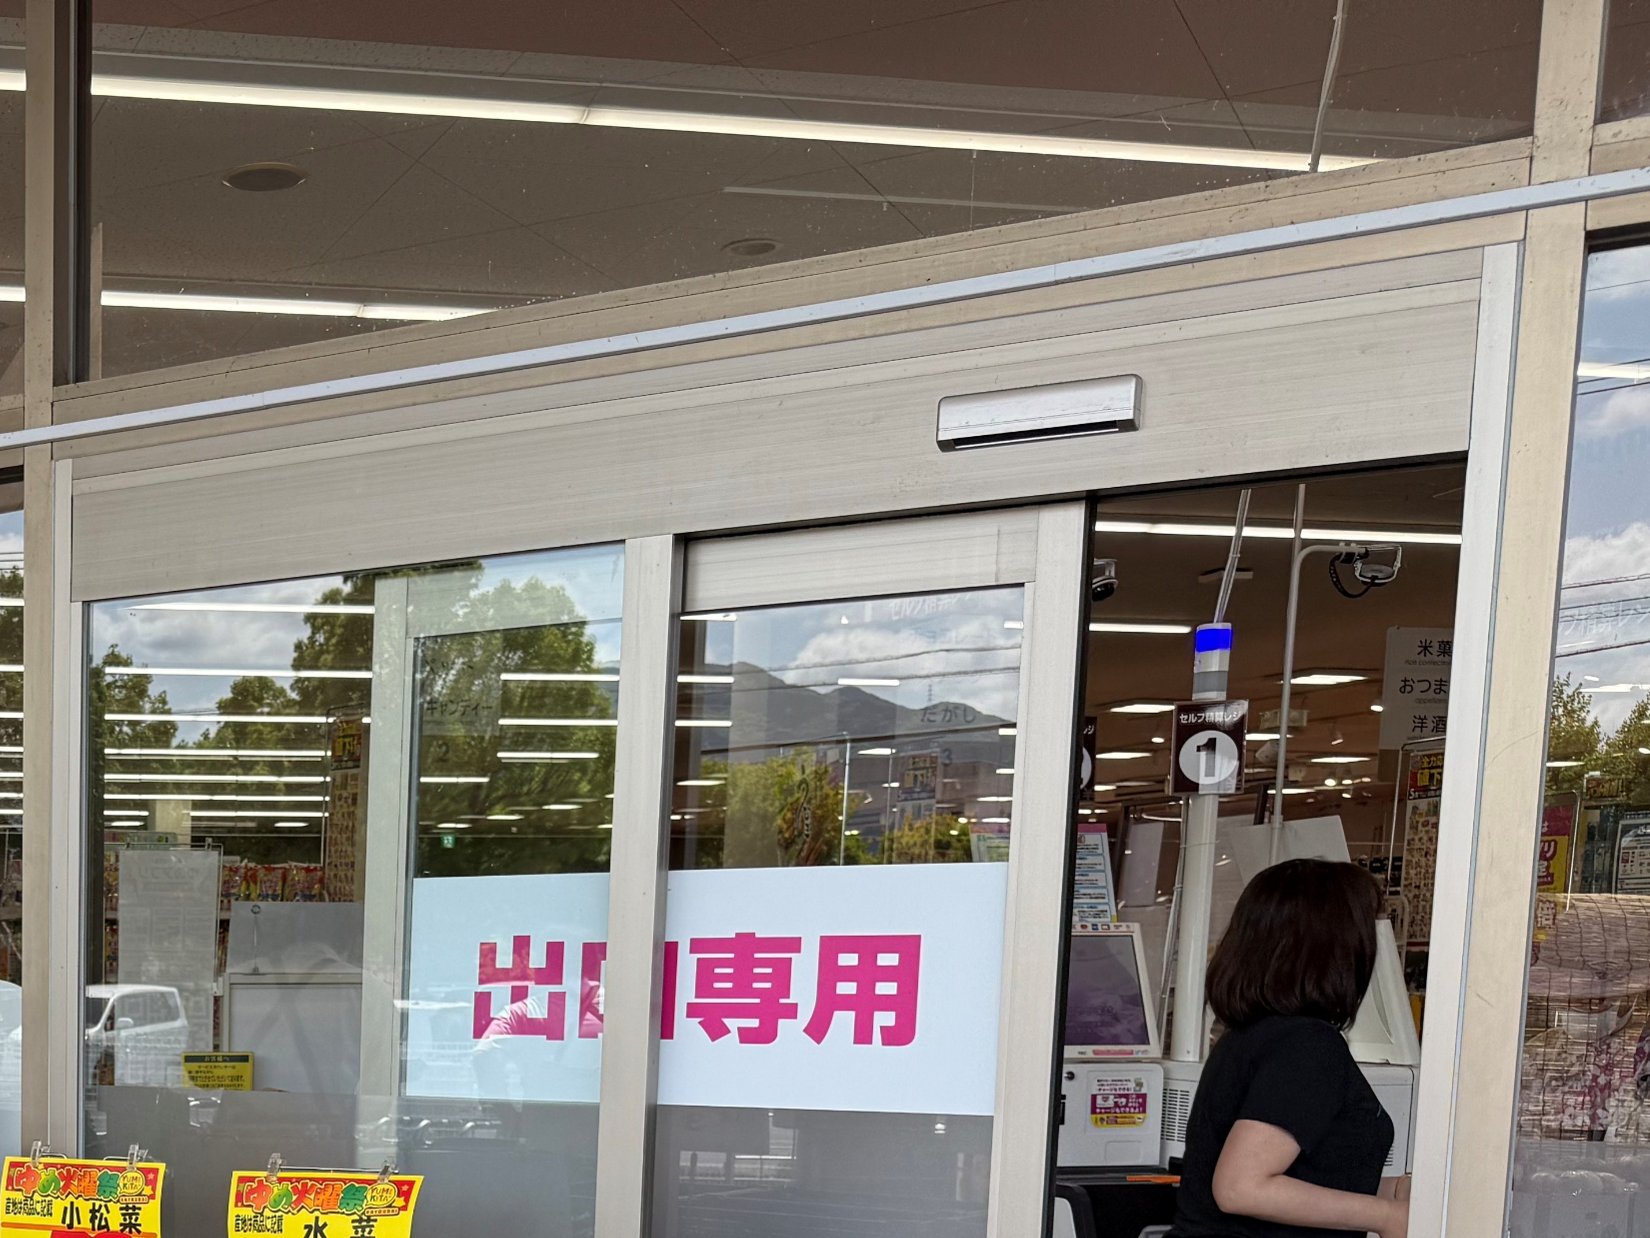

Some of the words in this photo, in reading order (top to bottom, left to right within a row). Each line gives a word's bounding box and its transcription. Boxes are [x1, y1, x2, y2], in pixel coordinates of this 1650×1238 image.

[60, 1201, 143, 1235] 小松菜
[234, 1214, 285, 1235] 産地は商品に記載
